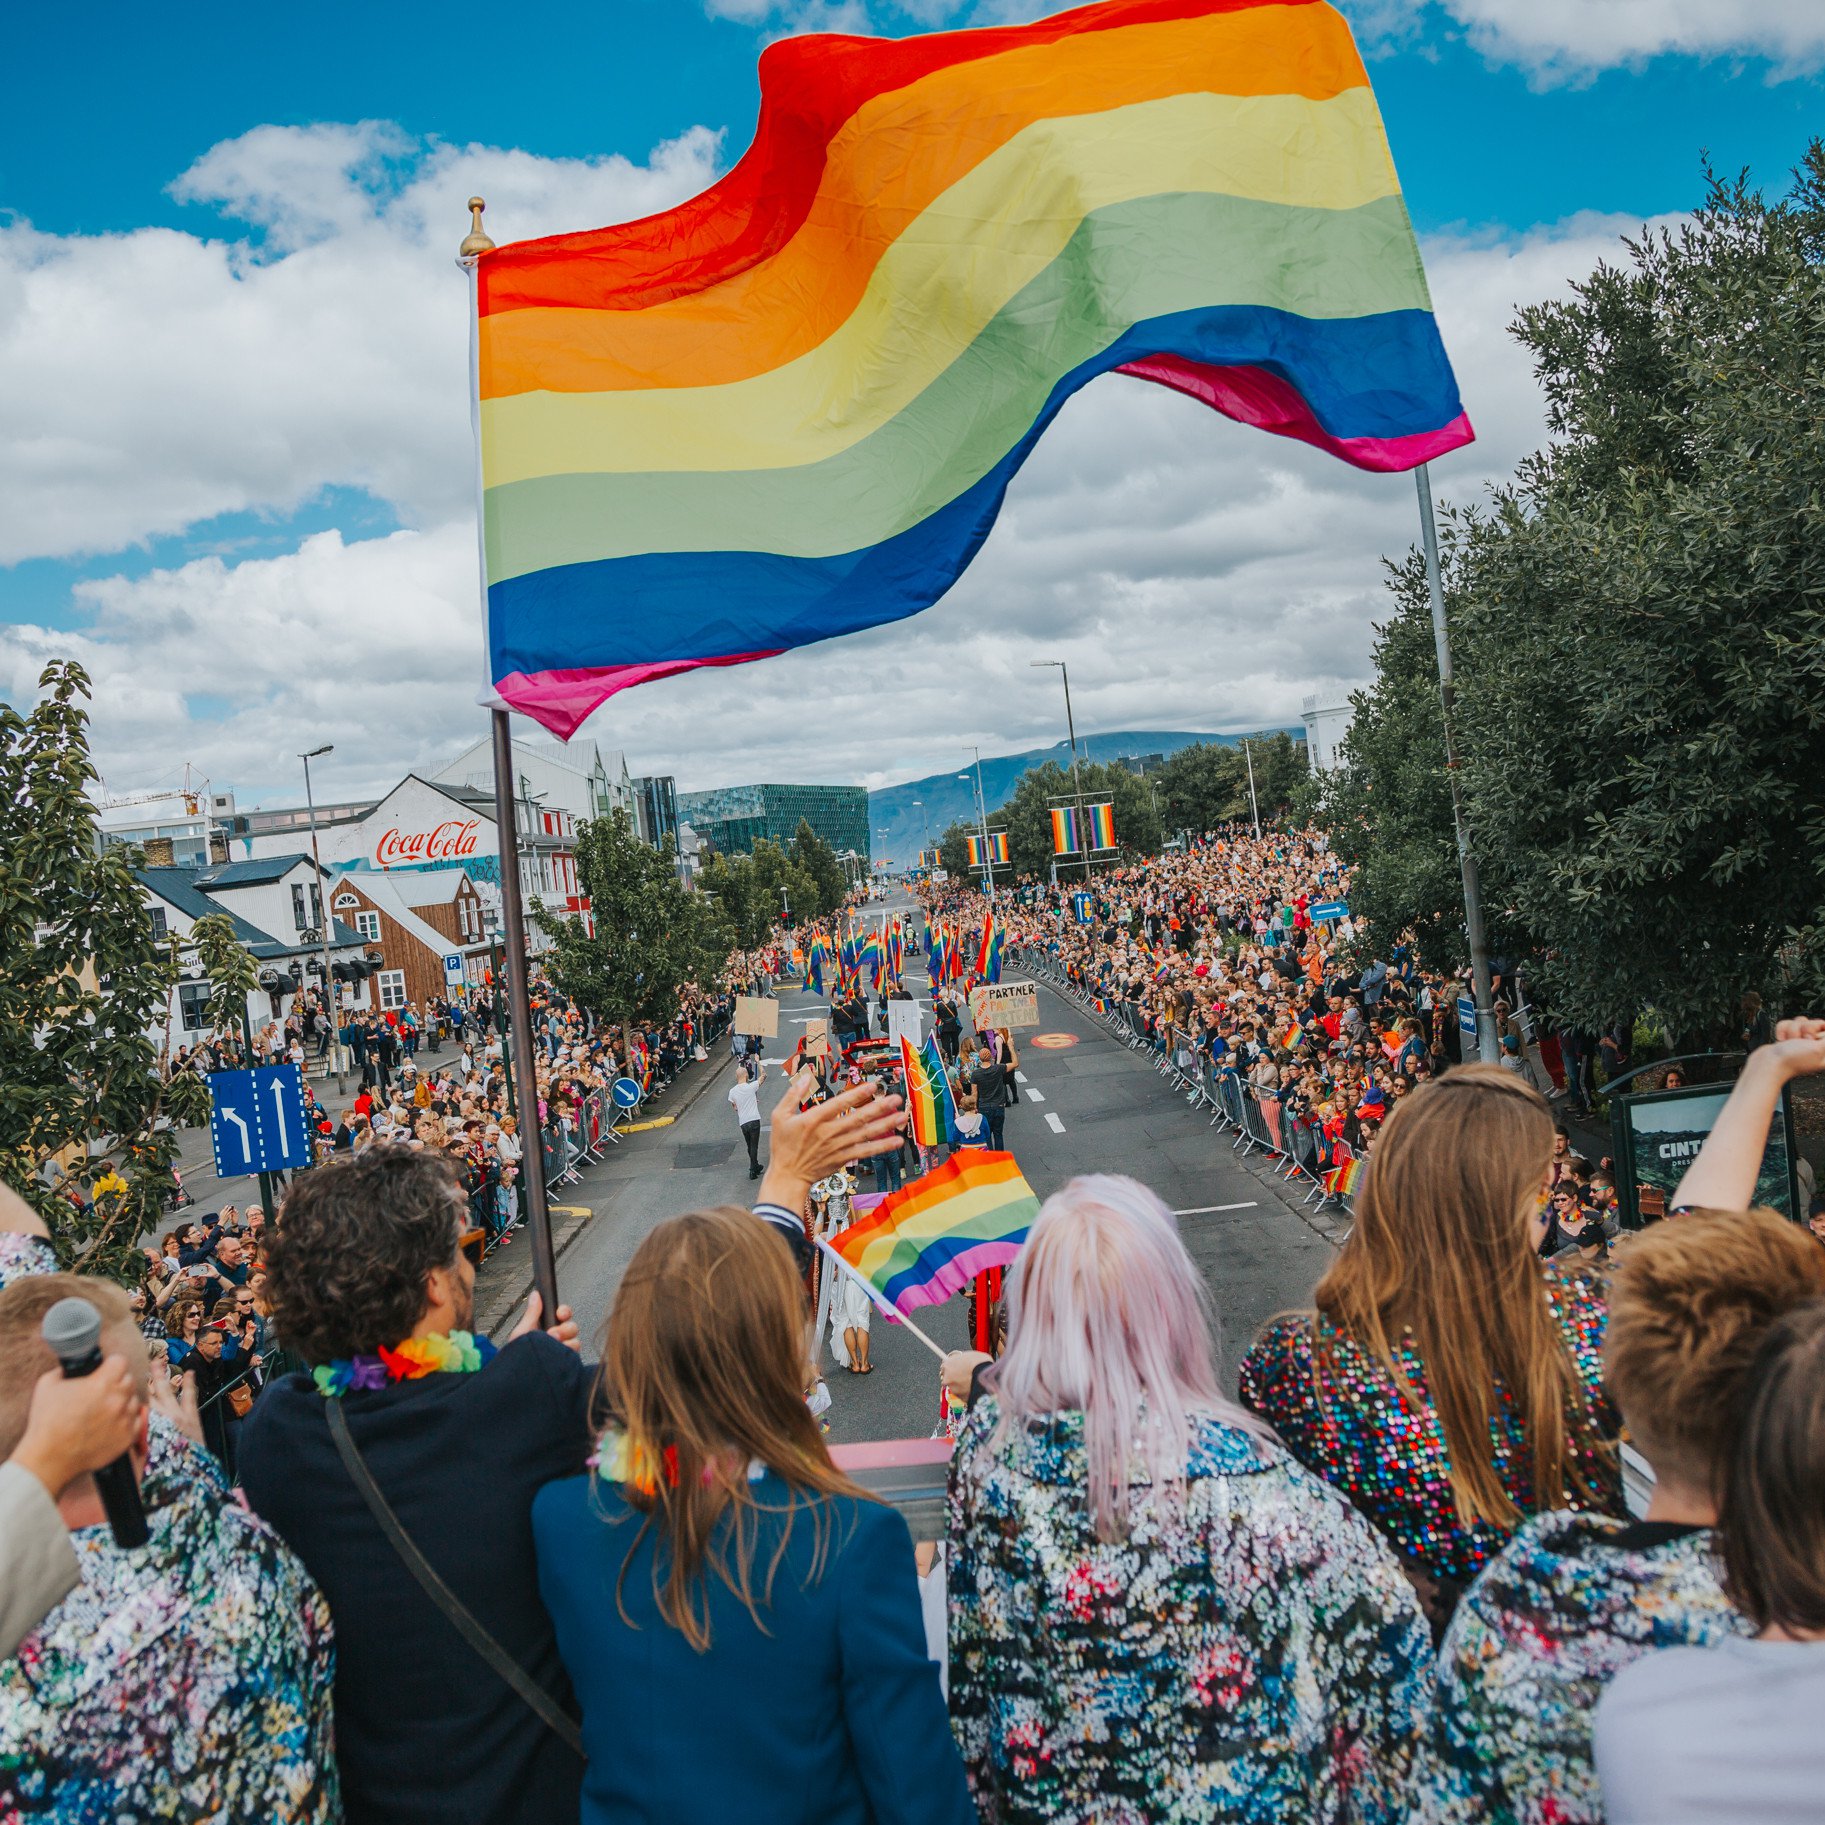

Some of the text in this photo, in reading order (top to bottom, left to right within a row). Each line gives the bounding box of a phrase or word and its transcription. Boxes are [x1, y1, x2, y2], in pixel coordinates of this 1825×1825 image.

[376, 820, 481, 864] Coca-Cola
[450, 959, 457, 968] P
[989, 984, 1035, 999] PARTNER
